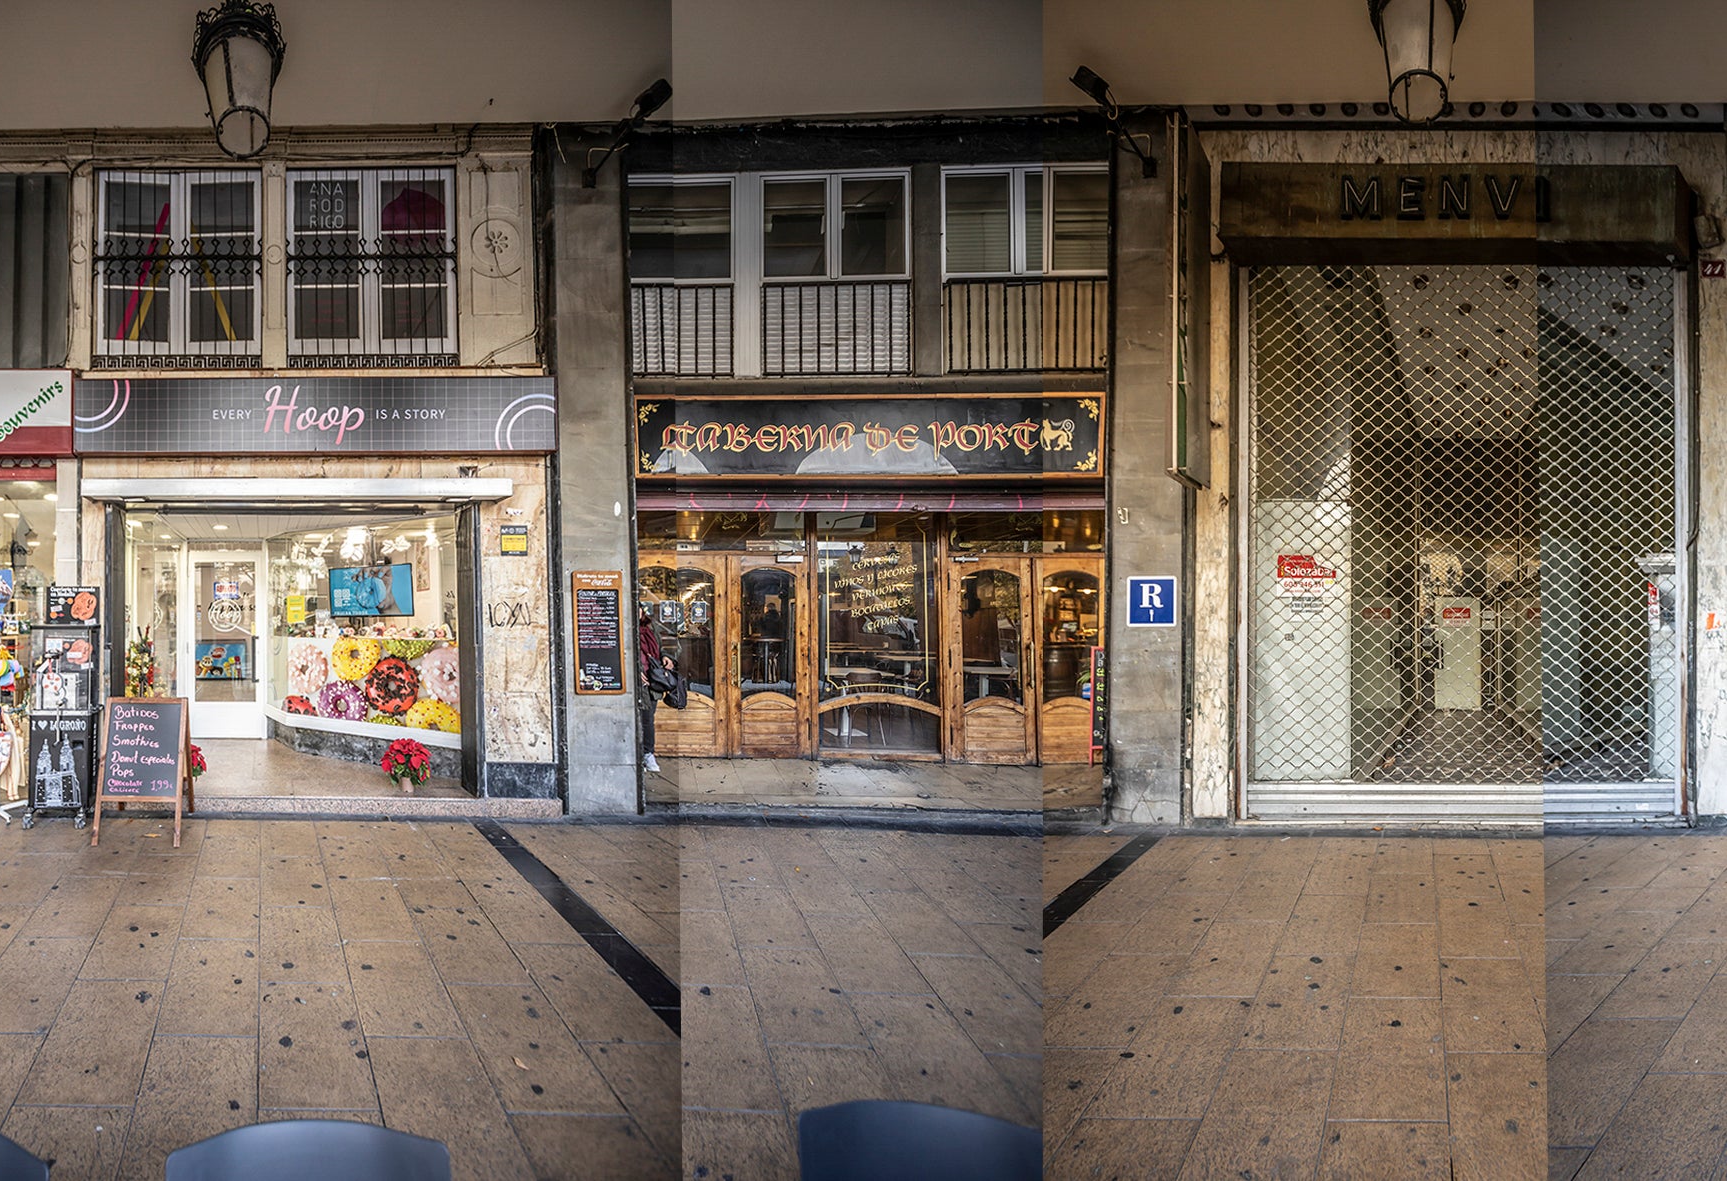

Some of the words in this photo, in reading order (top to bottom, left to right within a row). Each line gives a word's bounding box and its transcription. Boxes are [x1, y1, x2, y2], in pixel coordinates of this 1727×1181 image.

[309, 183, 344, 196] ANA
[309, 199, 344, 213] ROD
[309, 215, 344, 229] RIGO
[212, 409, 252, 420] EVERY
[263, 385, 365, 446] Hoop
[375, 409, 388, 420] IS
[392, 409, 401, 420] A
[404, 409, 447, 420] STORY
[863, 421, 920, 456] DE
[1139, 583, 1164, 608] R
[109, 763, 134, 777] Pops
